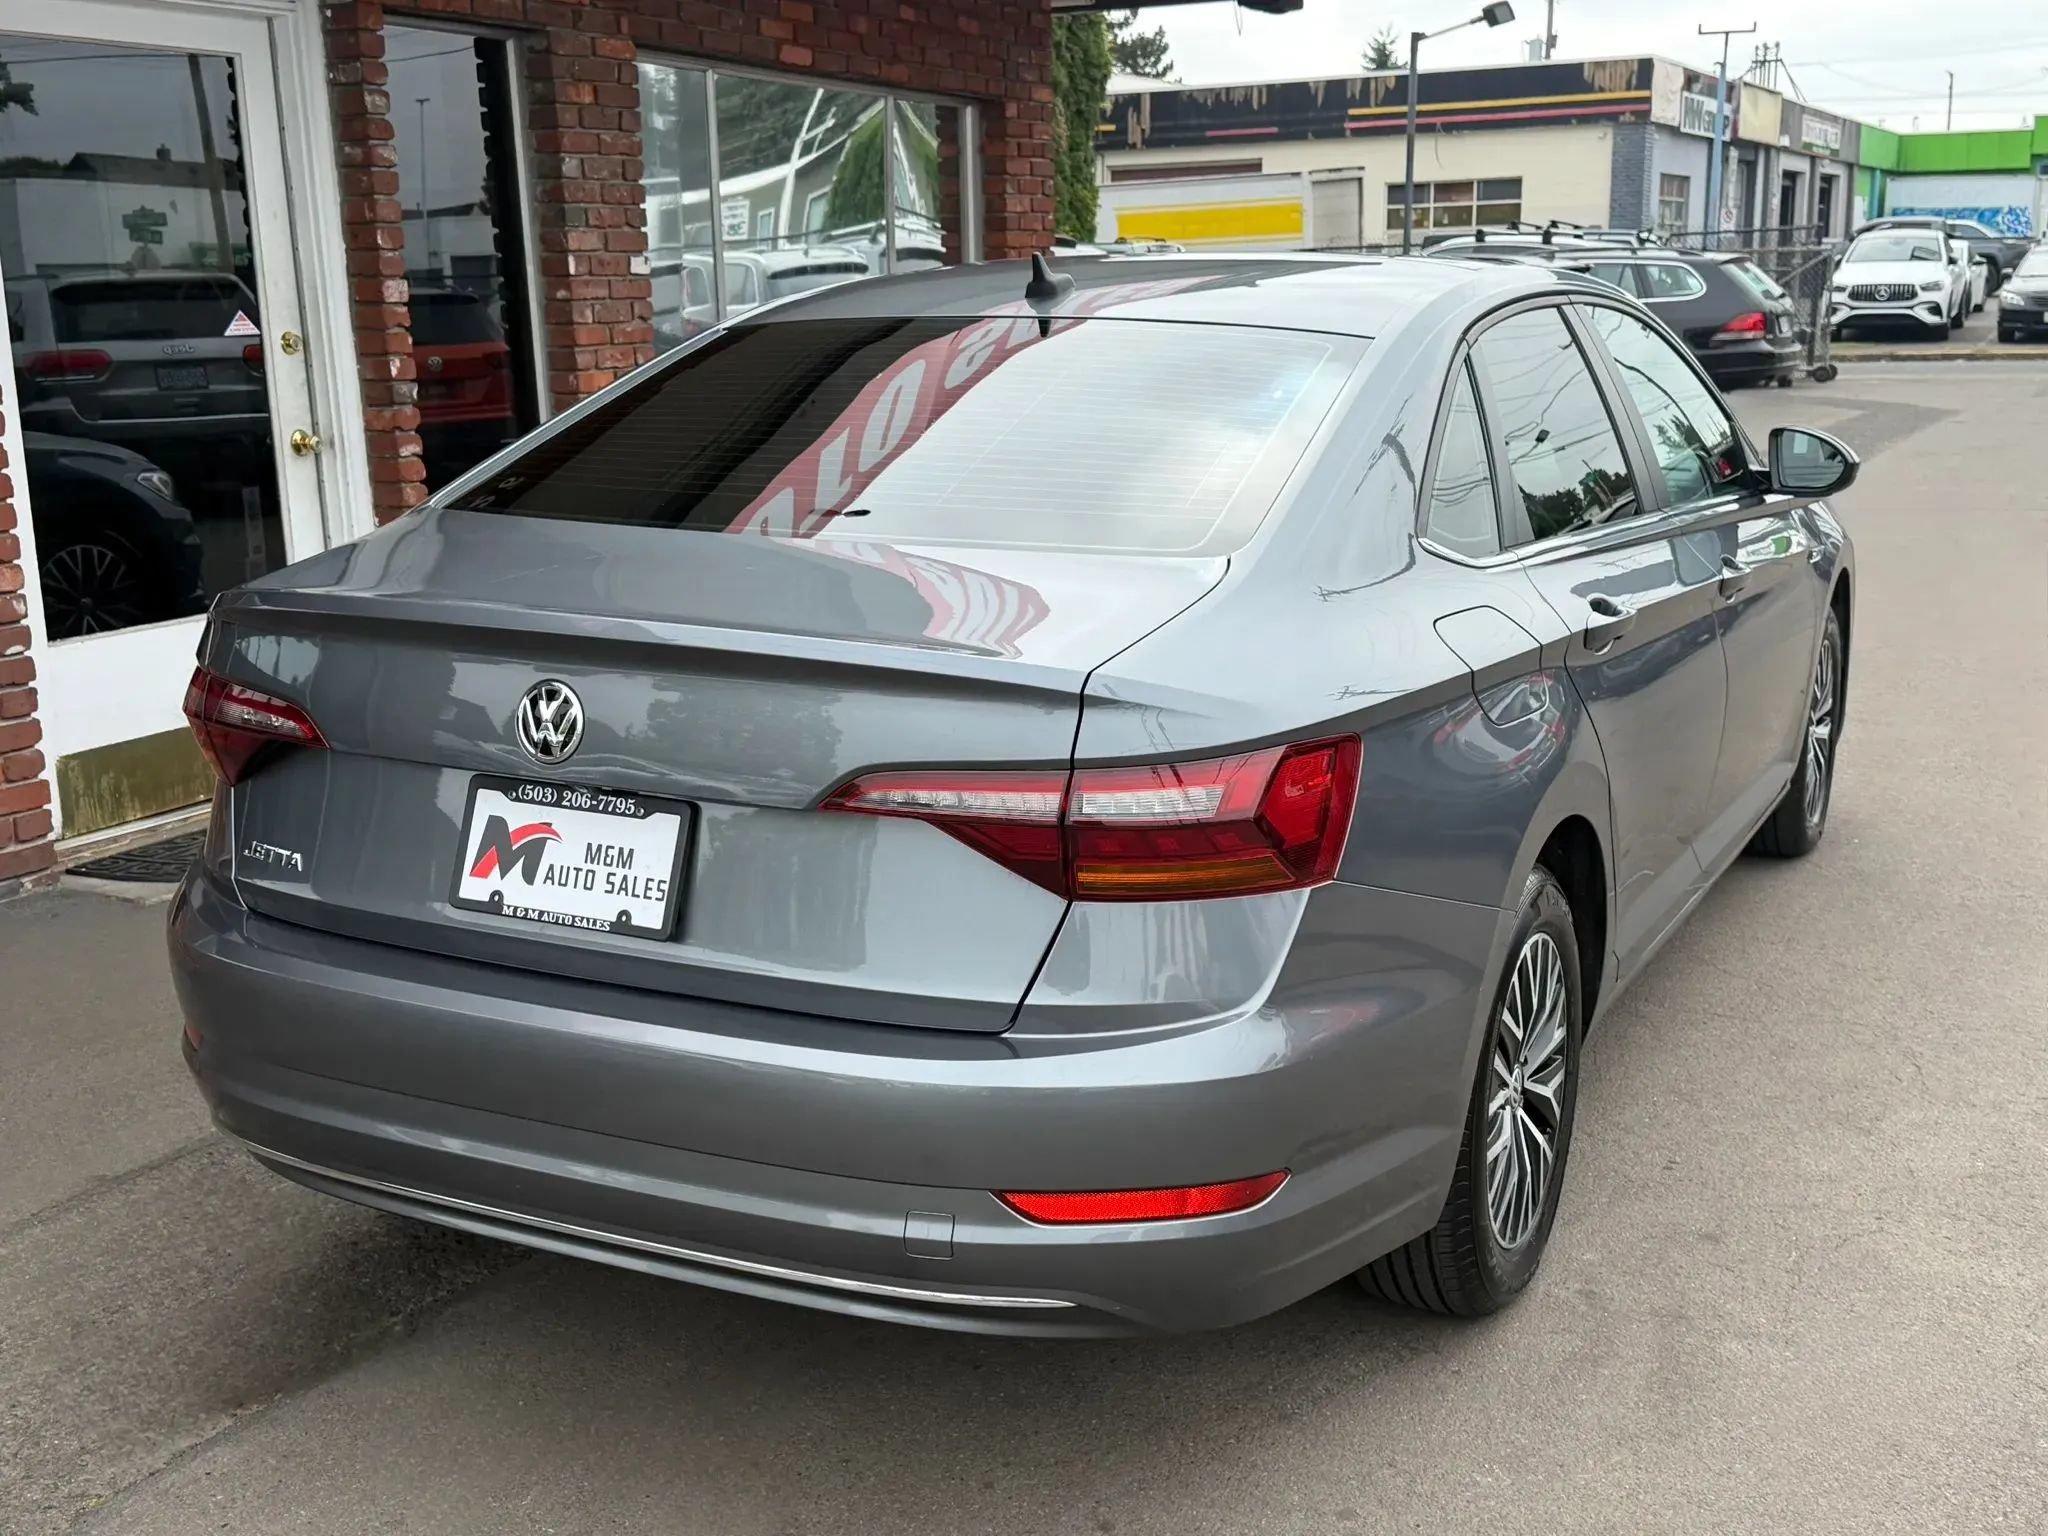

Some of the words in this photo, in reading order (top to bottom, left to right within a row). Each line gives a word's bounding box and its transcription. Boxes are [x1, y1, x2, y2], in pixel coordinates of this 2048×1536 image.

[518, 784, 558, 804] (503)
[561, 790, 636, 815] 206-7795
[243, 841, 303, 871] JETTA
[584, 842, 635, 870] M&M
[543, 863, 596, 891] AUTO
[604, 872, 668, 902] SALES
[502, 905, 514, 916] M
[527, 909, 540, 920] M
[541, 912, 573, 926] AUTO
[573, 916, 611, 931] SALES
